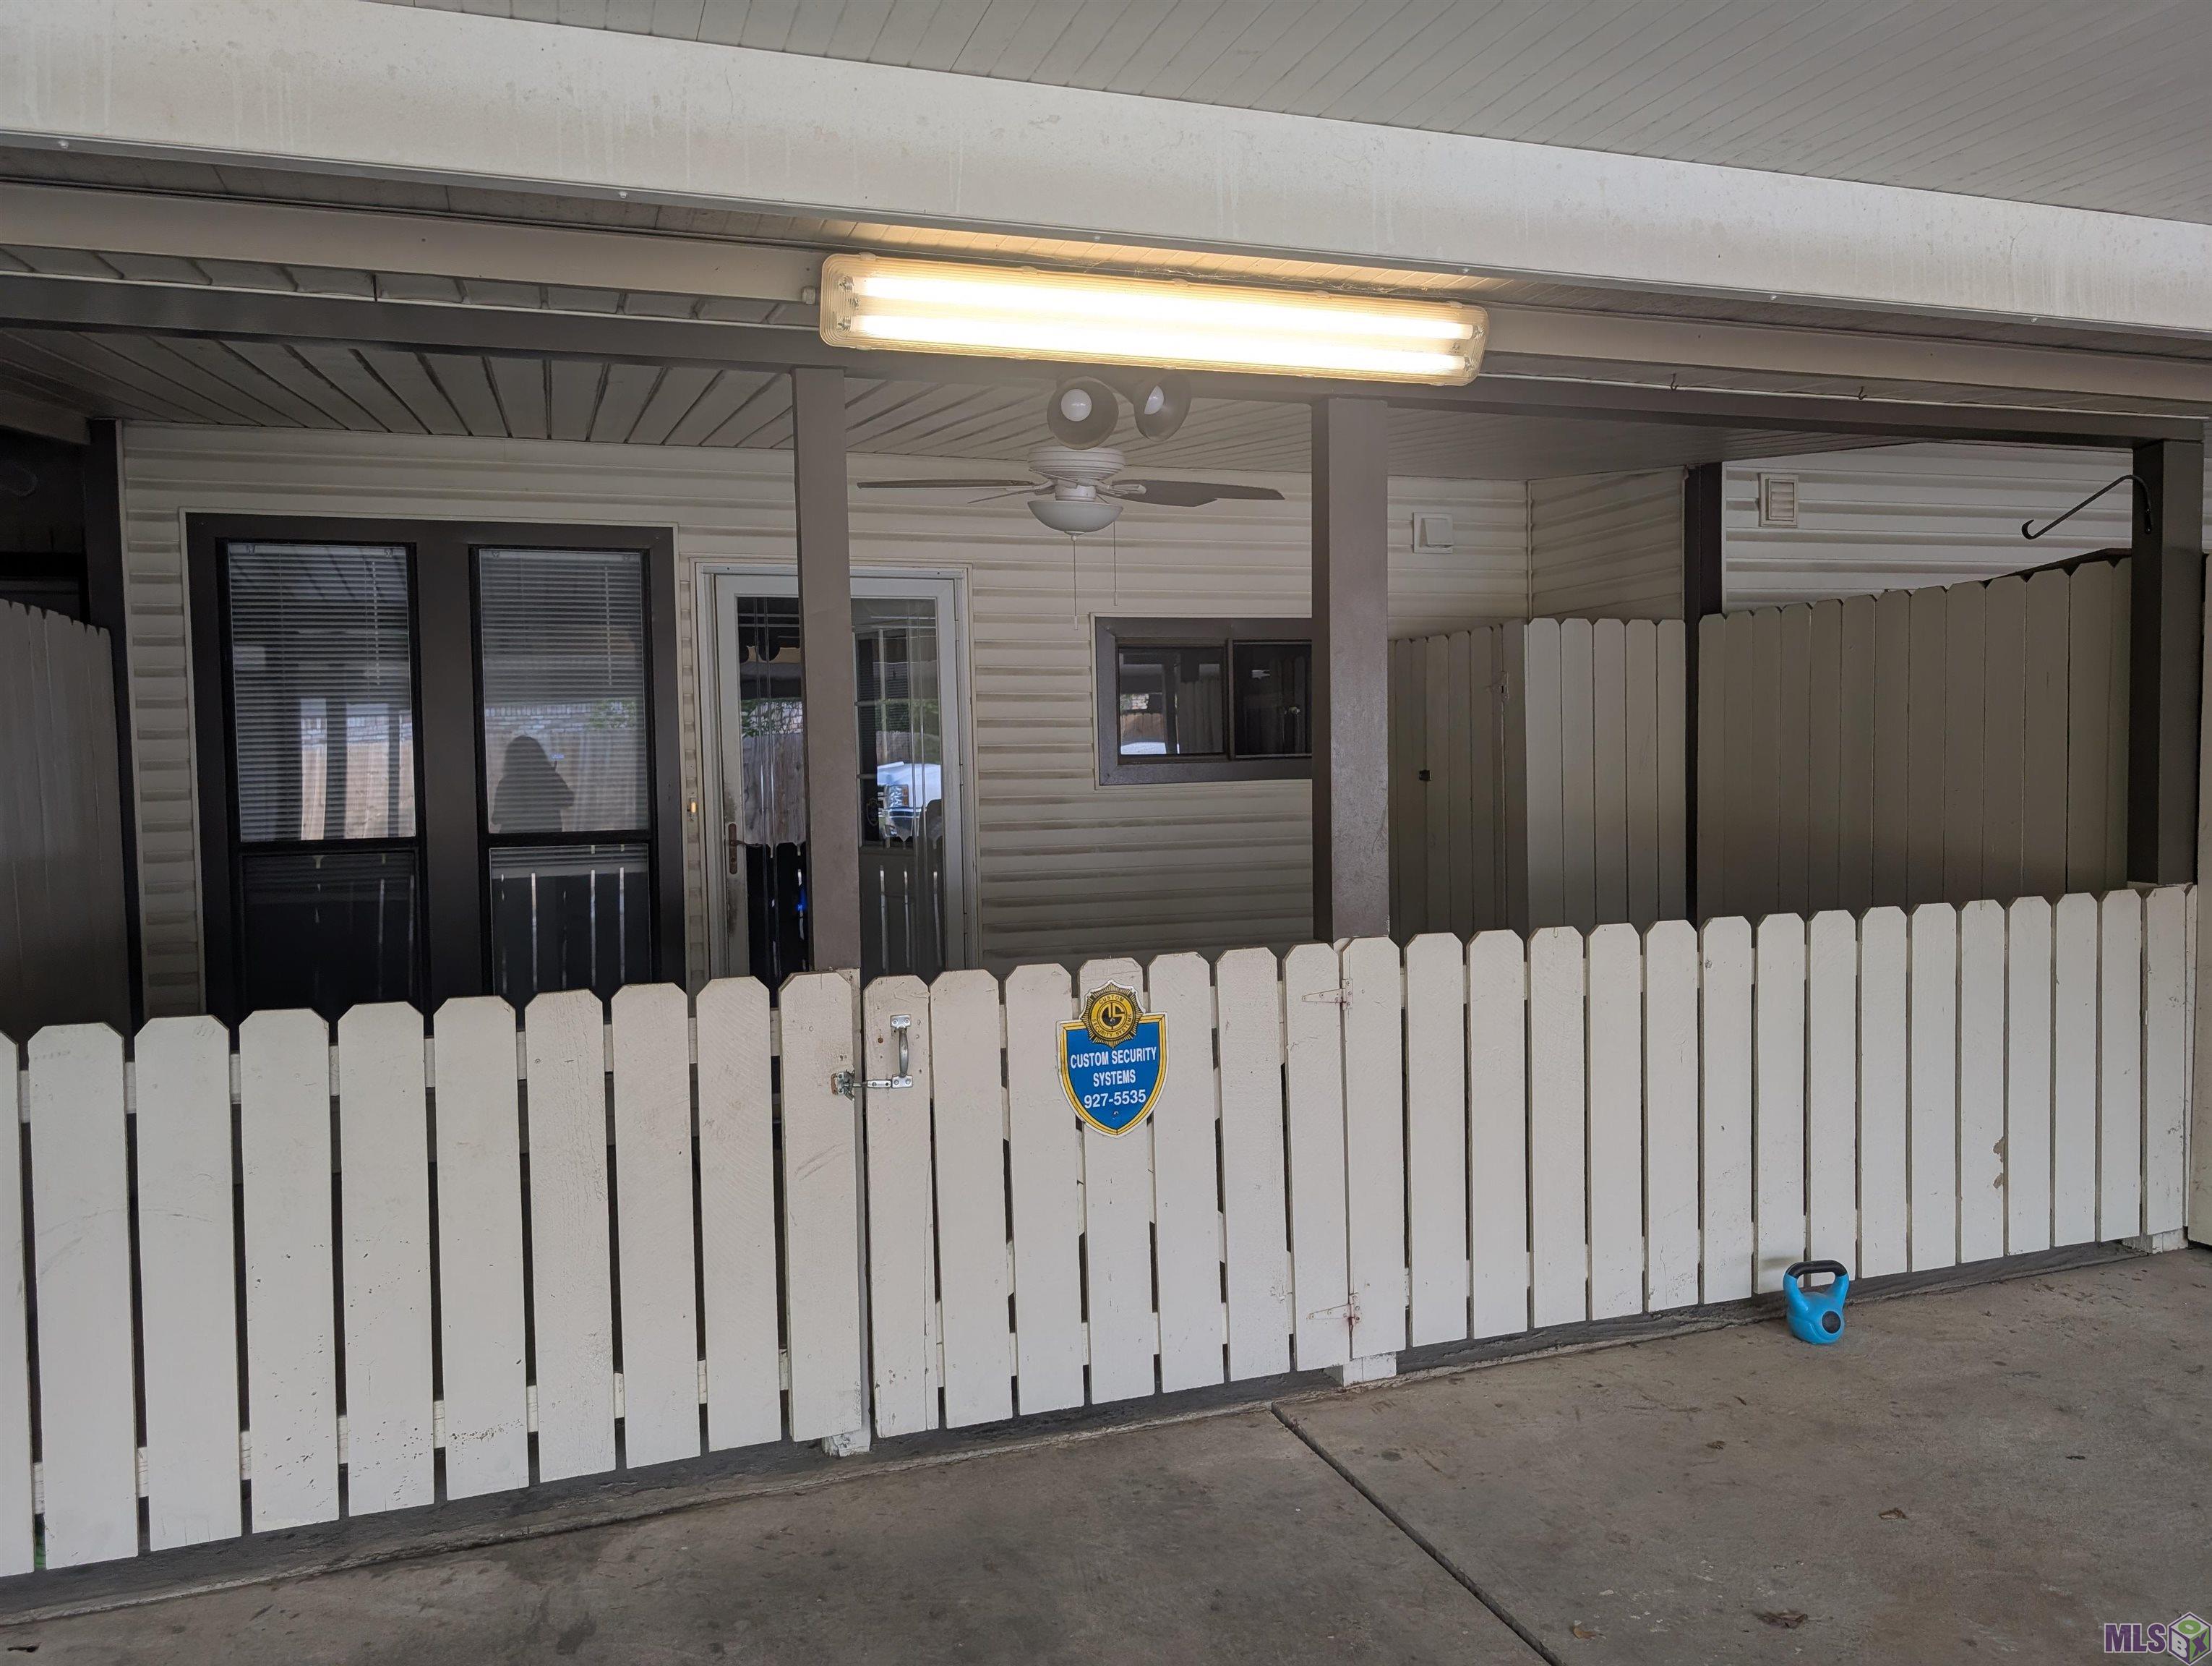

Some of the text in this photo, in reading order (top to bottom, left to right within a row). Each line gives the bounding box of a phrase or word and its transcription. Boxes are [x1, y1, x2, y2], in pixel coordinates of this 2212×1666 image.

[1098, 994, 1125, 1004] CUSTOM
[1092, 1013, 1133, 1038] SECURITY SYSTEMS
[1071, 1047, 1157, 1069] CUSTOM SECURITY
[1093, 1069, 1136, 1088] SYSTEMS
[1084, 1089, 1146, 1108] 927-5535
